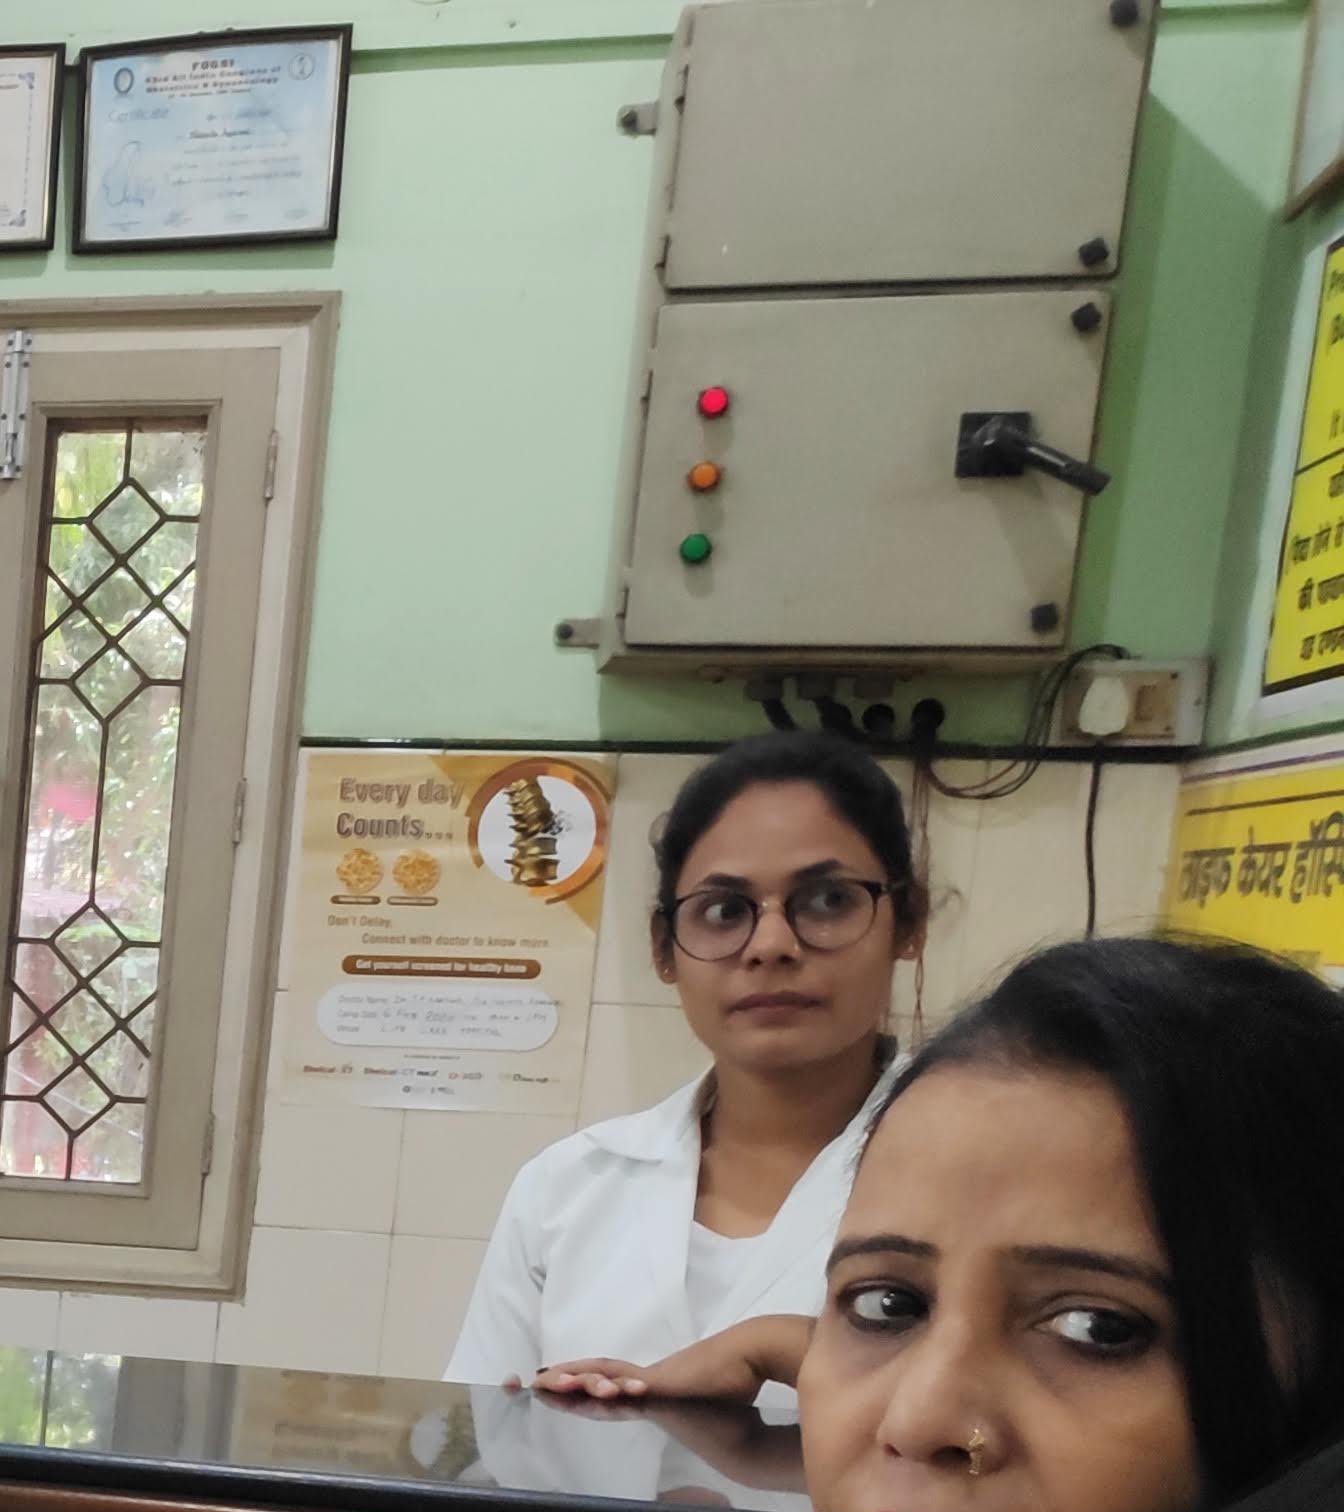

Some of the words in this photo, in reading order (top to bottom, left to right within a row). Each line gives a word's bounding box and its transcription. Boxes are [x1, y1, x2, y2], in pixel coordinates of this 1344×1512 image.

[339, 778, 411, 808] Every
[418, 778, 464, 809] day
[362, 930, 406, 945] Connect
[435, 934, 470, 946] doctor
